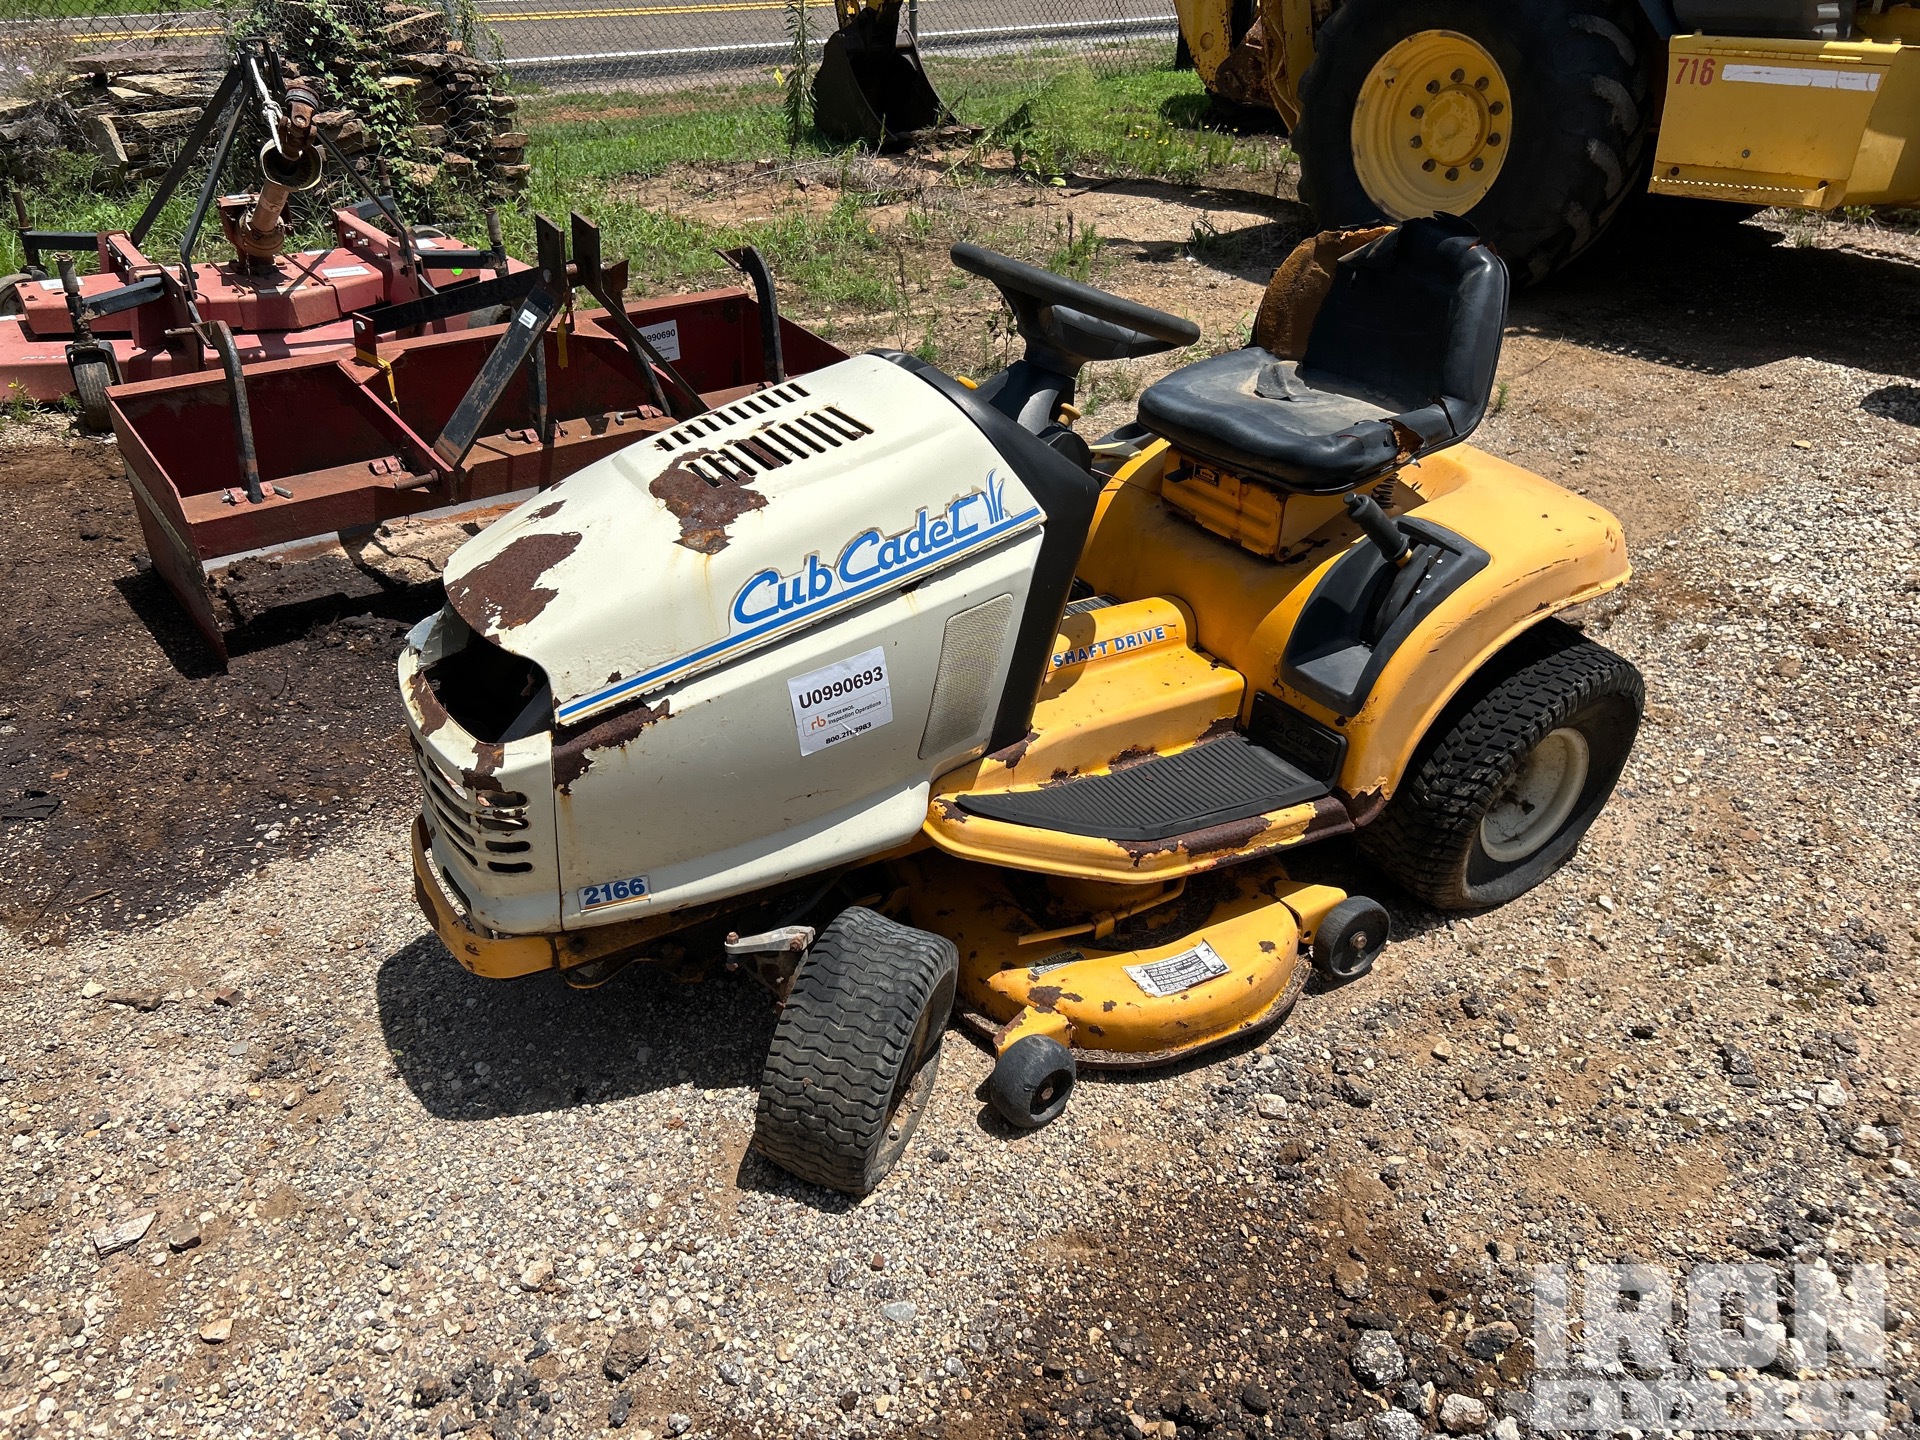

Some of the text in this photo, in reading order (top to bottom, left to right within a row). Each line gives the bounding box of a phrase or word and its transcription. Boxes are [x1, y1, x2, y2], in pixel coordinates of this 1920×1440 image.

[1675, 58, 1716, 86] 716
[644, 328, 676, 343] 990690
[733, 496, 979, 625] Cub Cadet
[1052, 626, 1166, 668] SHAFT DRIVE
[798, 665, 884, 710] U0990693
[828, 700, 882, 725] Inspection Operations
[825, 721, 872, 745] 800.211.3983
[583, 877, 646, 906] 2166
[1042, 950, 1073, 964] CAUTION
